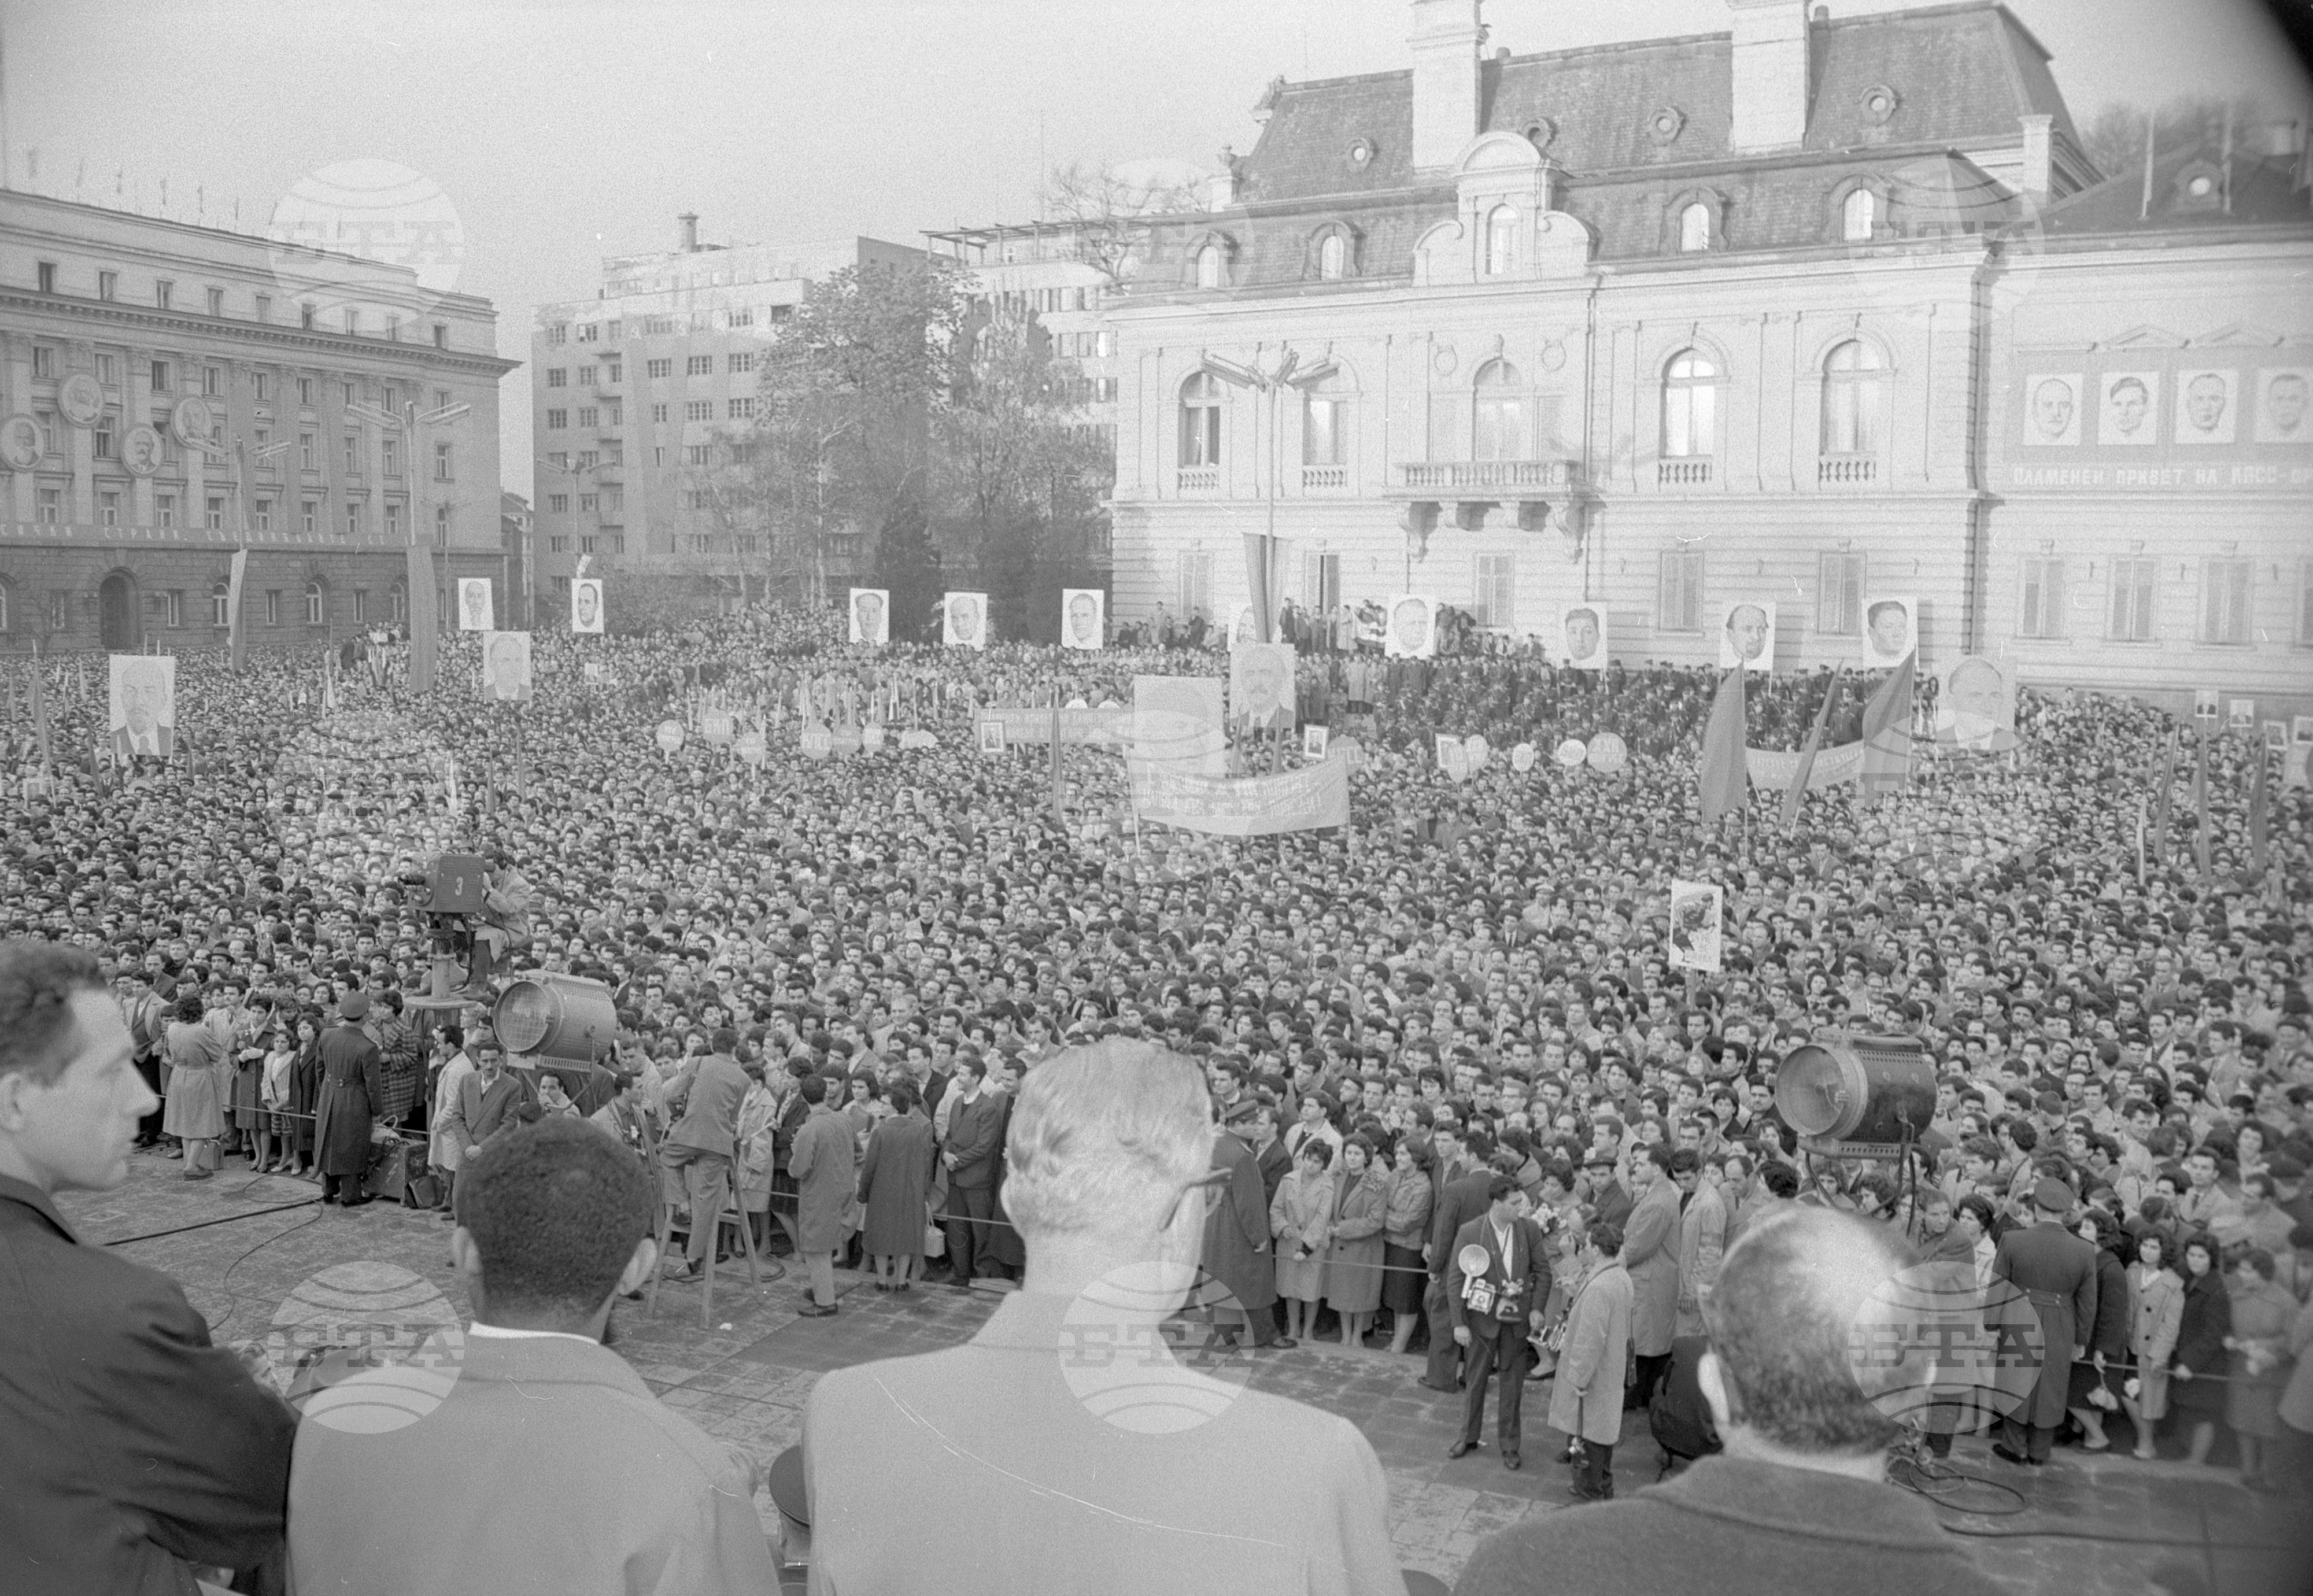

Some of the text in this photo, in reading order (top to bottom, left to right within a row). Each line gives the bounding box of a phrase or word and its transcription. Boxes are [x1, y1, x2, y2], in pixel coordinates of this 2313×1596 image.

[2013, 467, 2104, 486] ПЛАМЕНЕН
[2116, 468, 2186, 485] ПРИВЕТ
[2194, 467, 2218, 485] НА
[455, 876, 463, 896] 3
